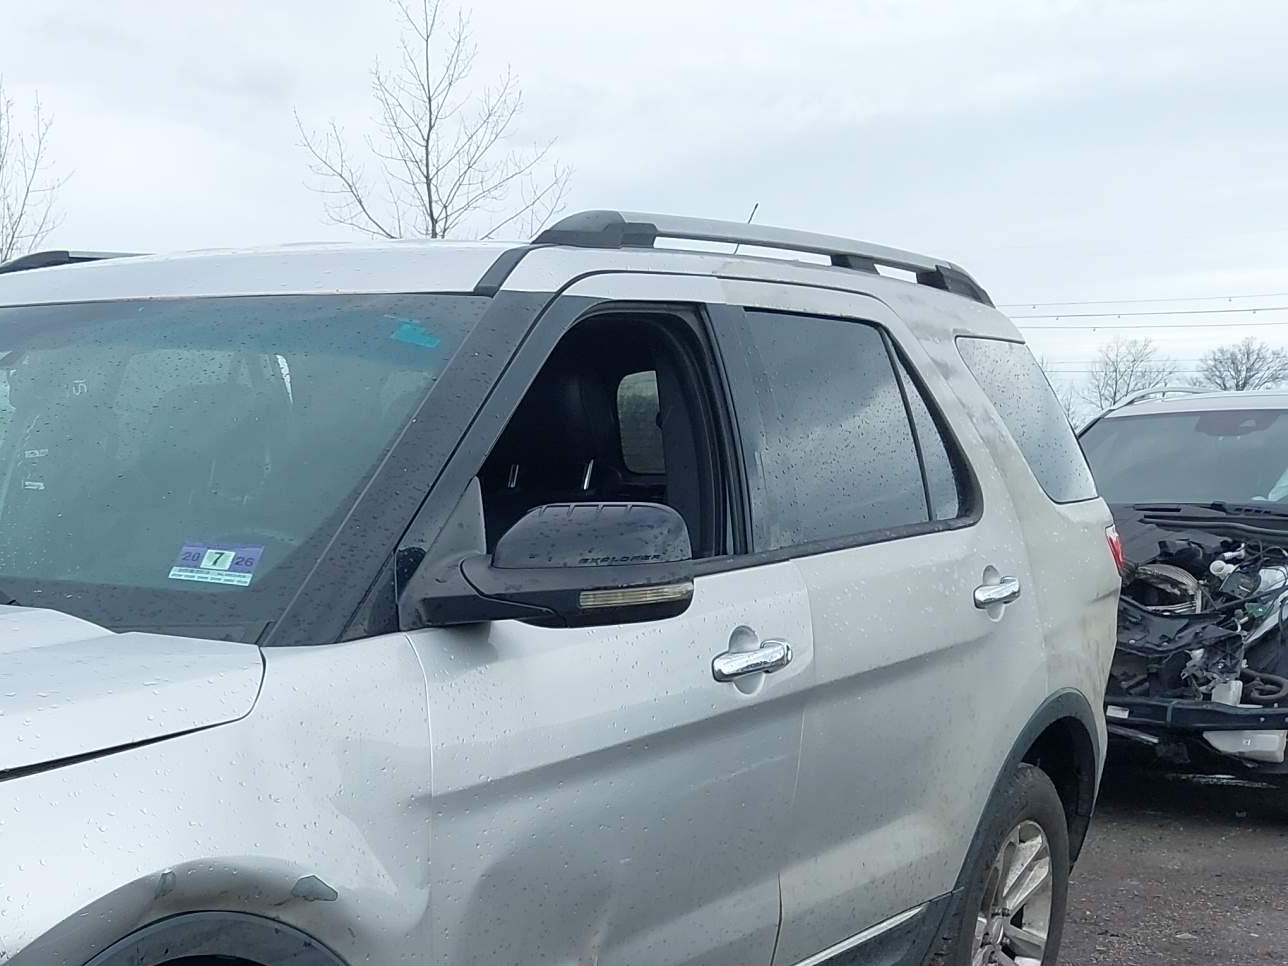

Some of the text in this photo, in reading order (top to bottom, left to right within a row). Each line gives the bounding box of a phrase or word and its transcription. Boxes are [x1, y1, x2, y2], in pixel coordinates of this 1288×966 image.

[182, 551, 254, 567] 20 7 26
[578, 554, 661, 566] EXPLORER
